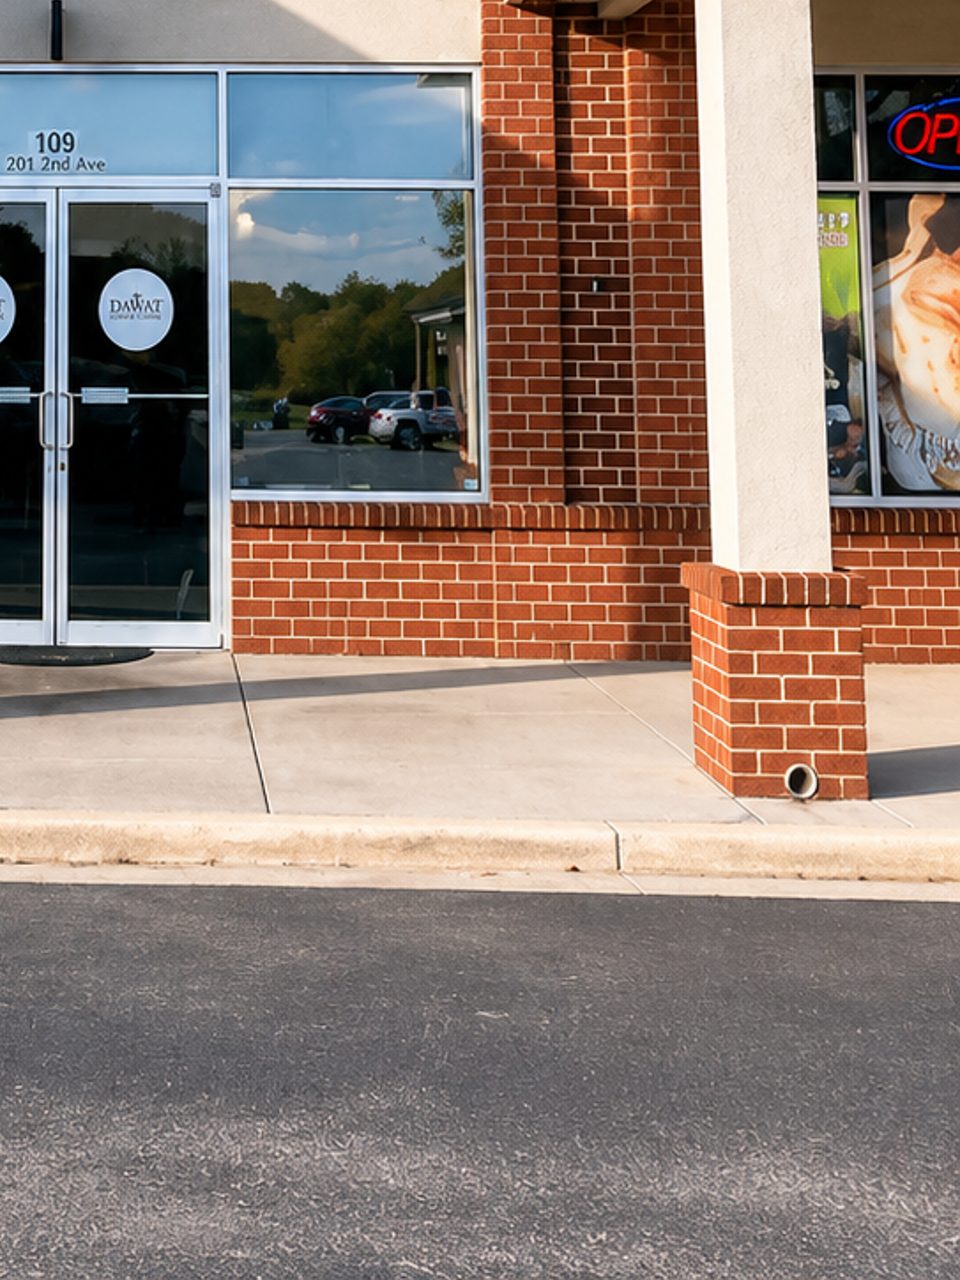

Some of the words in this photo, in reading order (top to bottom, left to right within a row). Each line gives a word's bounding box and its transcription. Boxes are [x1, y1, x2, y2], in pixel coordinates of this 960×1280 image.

[35, 131, 75, 154] 109
[895, 111, 960, 155] OP
[6, 156, 34, 171] 201
[41, 155, 70, 171] 2nd
[76, 157, 106, 171] Ave
[110, 297, 164, 312] DAWAT
